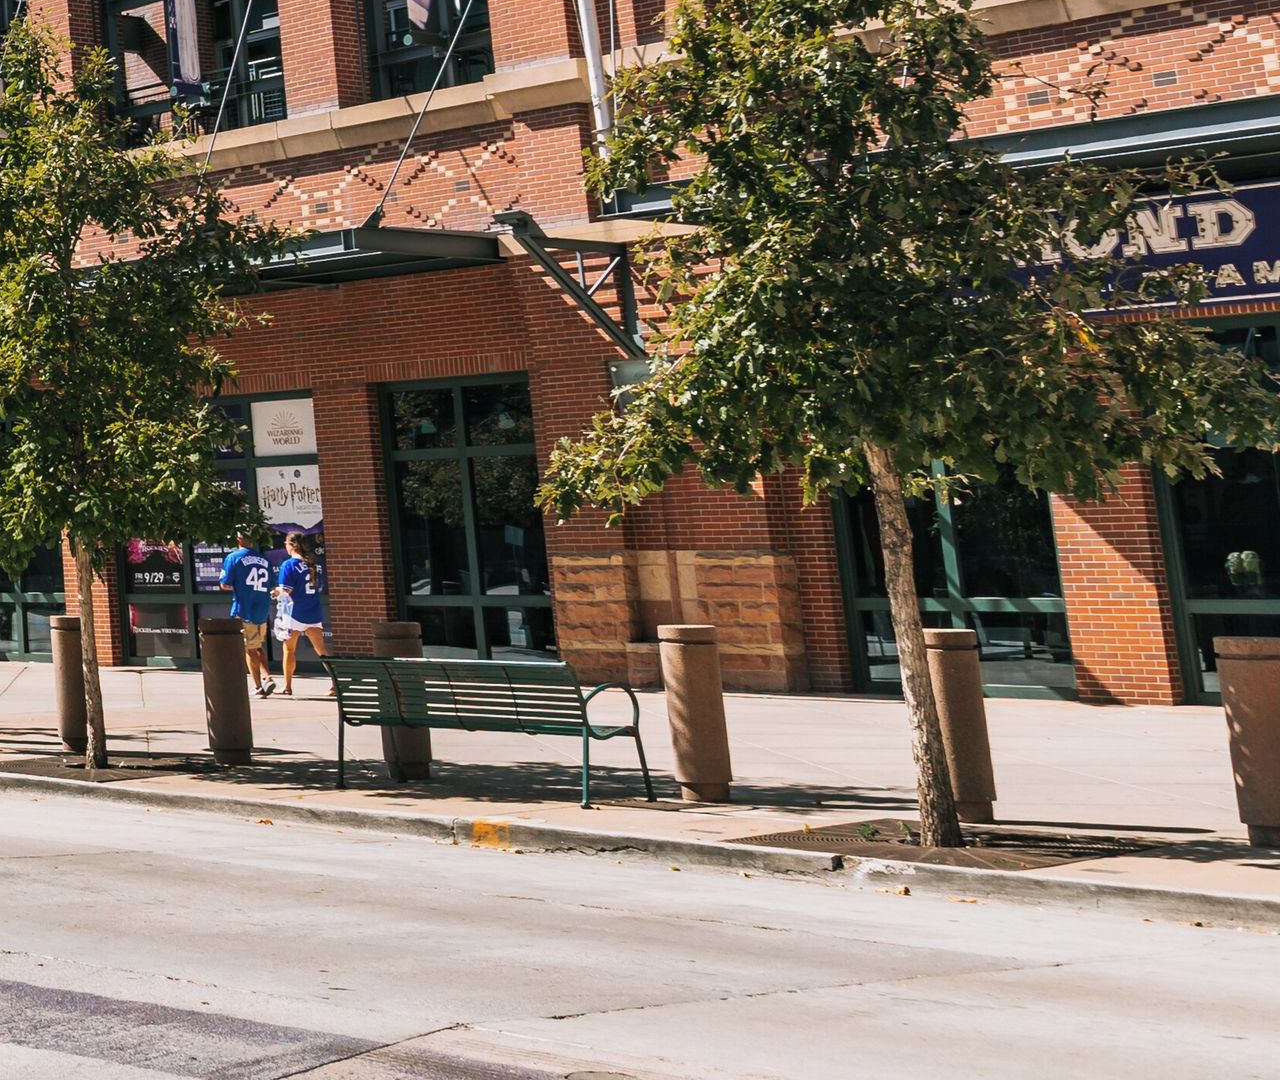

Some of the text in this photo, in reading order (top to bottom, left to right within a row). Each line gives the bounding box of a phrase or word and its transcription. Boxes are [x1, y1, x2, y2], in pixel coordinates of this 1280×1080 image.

[267, 429, 304, 438] WIZARDING
[273, 437, 300, 446] WORLD
[262, 482, 320, 510] Harry Potter
[144, 572, 165, 583] 9/29
[245, 567, 269, 592] 42
